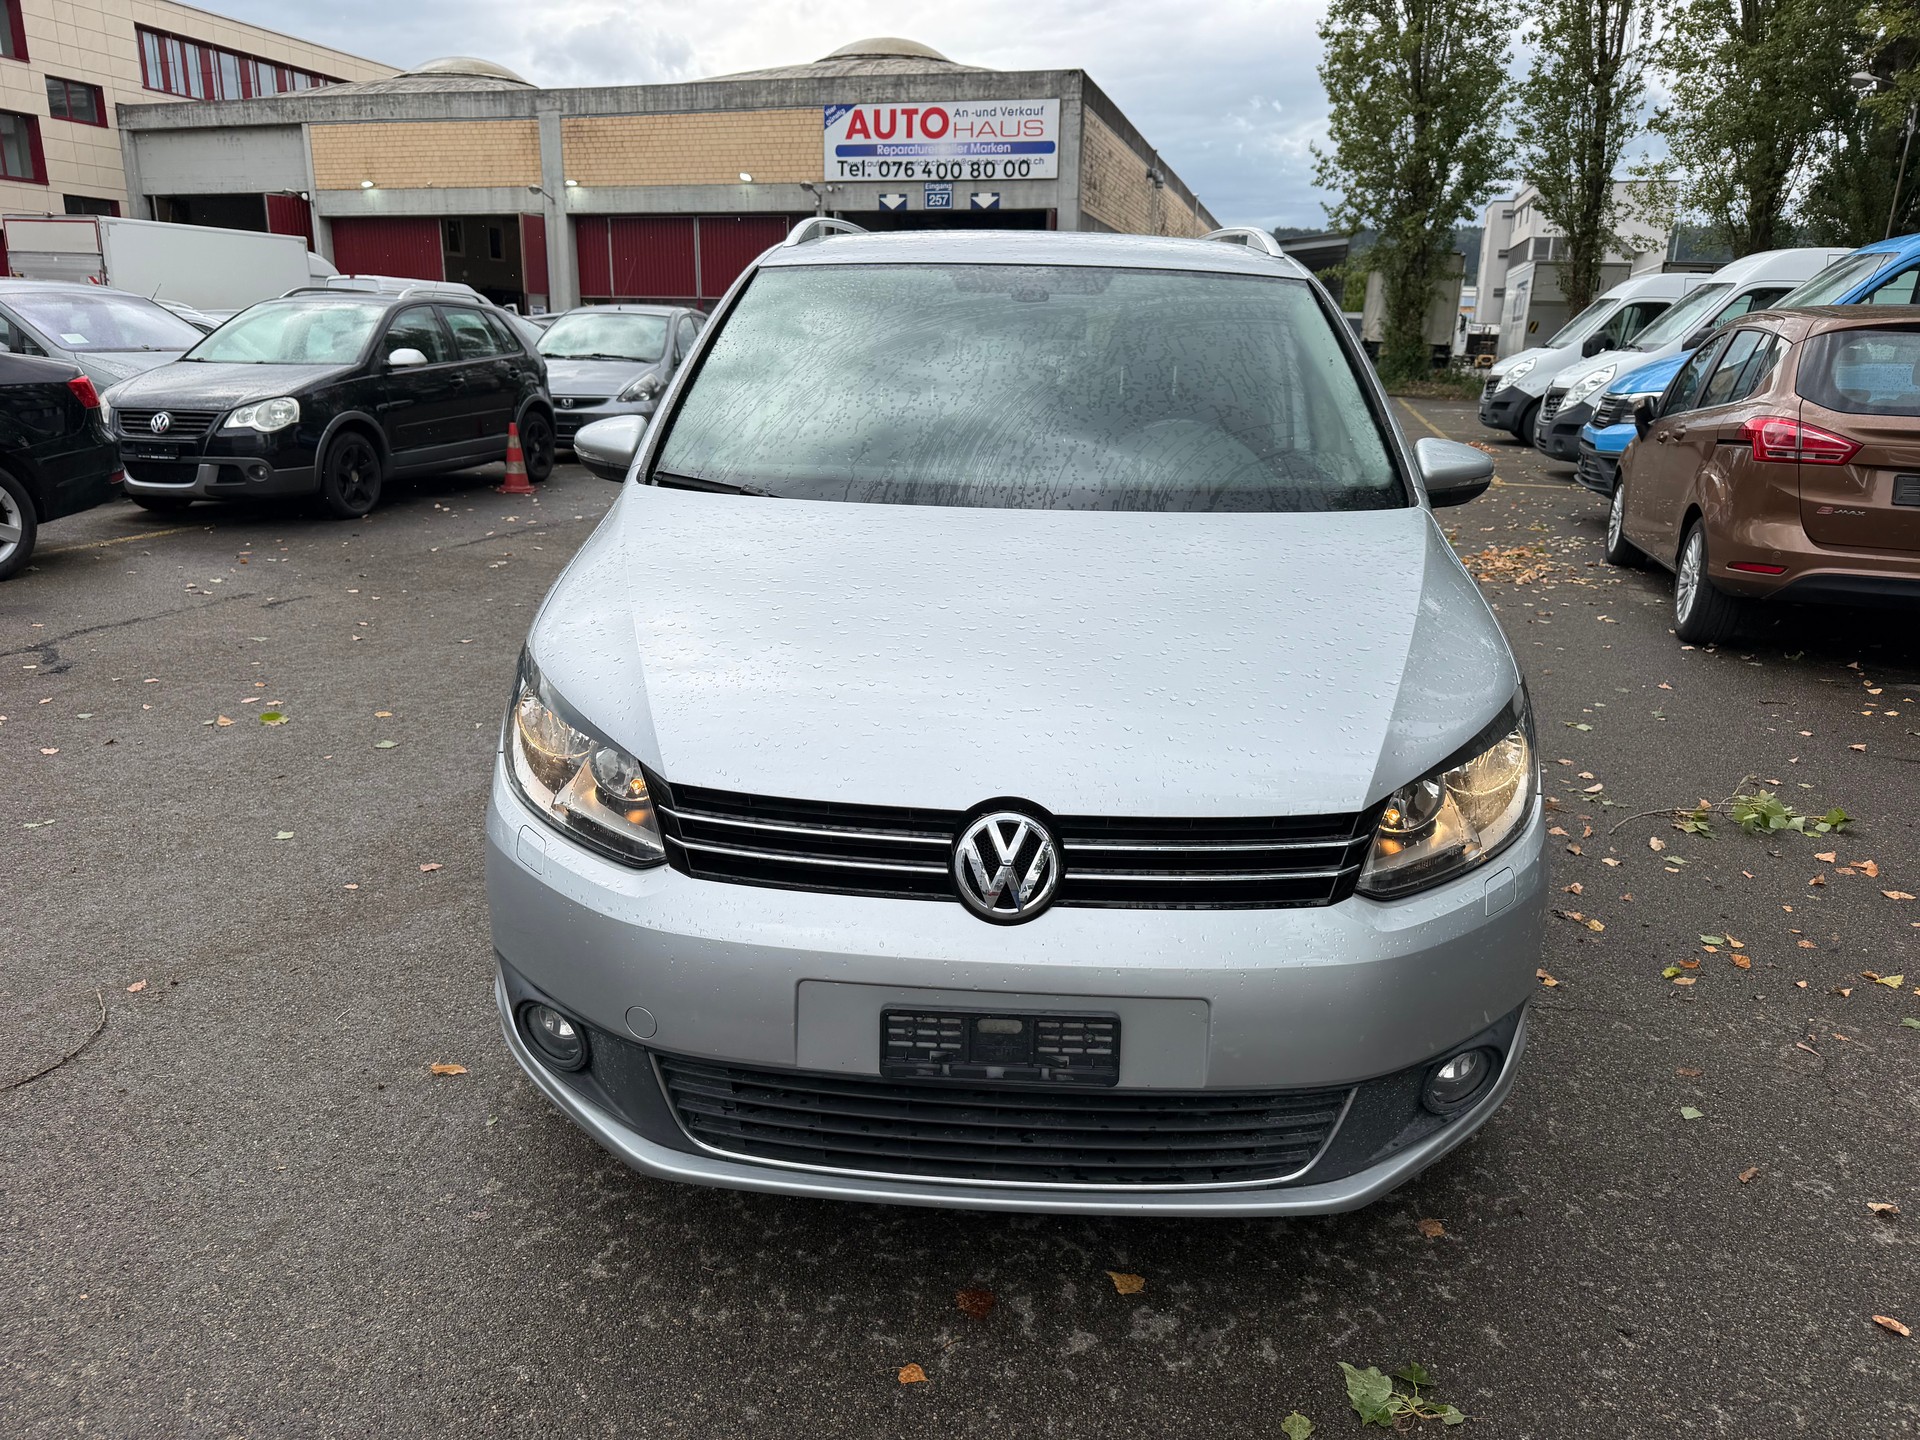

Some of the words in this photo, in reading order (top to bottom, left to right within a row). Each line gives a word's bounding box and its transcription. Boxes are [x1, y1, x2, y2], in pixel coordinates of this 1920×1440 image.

[953, 108, 969, 118] An
[1000, 105, 1045, 117] Verkauf
[845, 108, 950, 140] AUTO
[953, 119, 1044, 138] HAUS
[876, 144, 938, 156] Reparature
[970, 142, 1011, 154] Marken
[837, 160, 871, 178] Tel.
[879, 160, 915, 179] 076
[922, 161, 962, 180] 400
[970, 161, 995, 179] 80
[1003, 160, 1030, 178] 00
[925, 182, 953, 191] Eingang
[929, 194, 949, 206] 257
[955, 811, 1059, 919] VW
